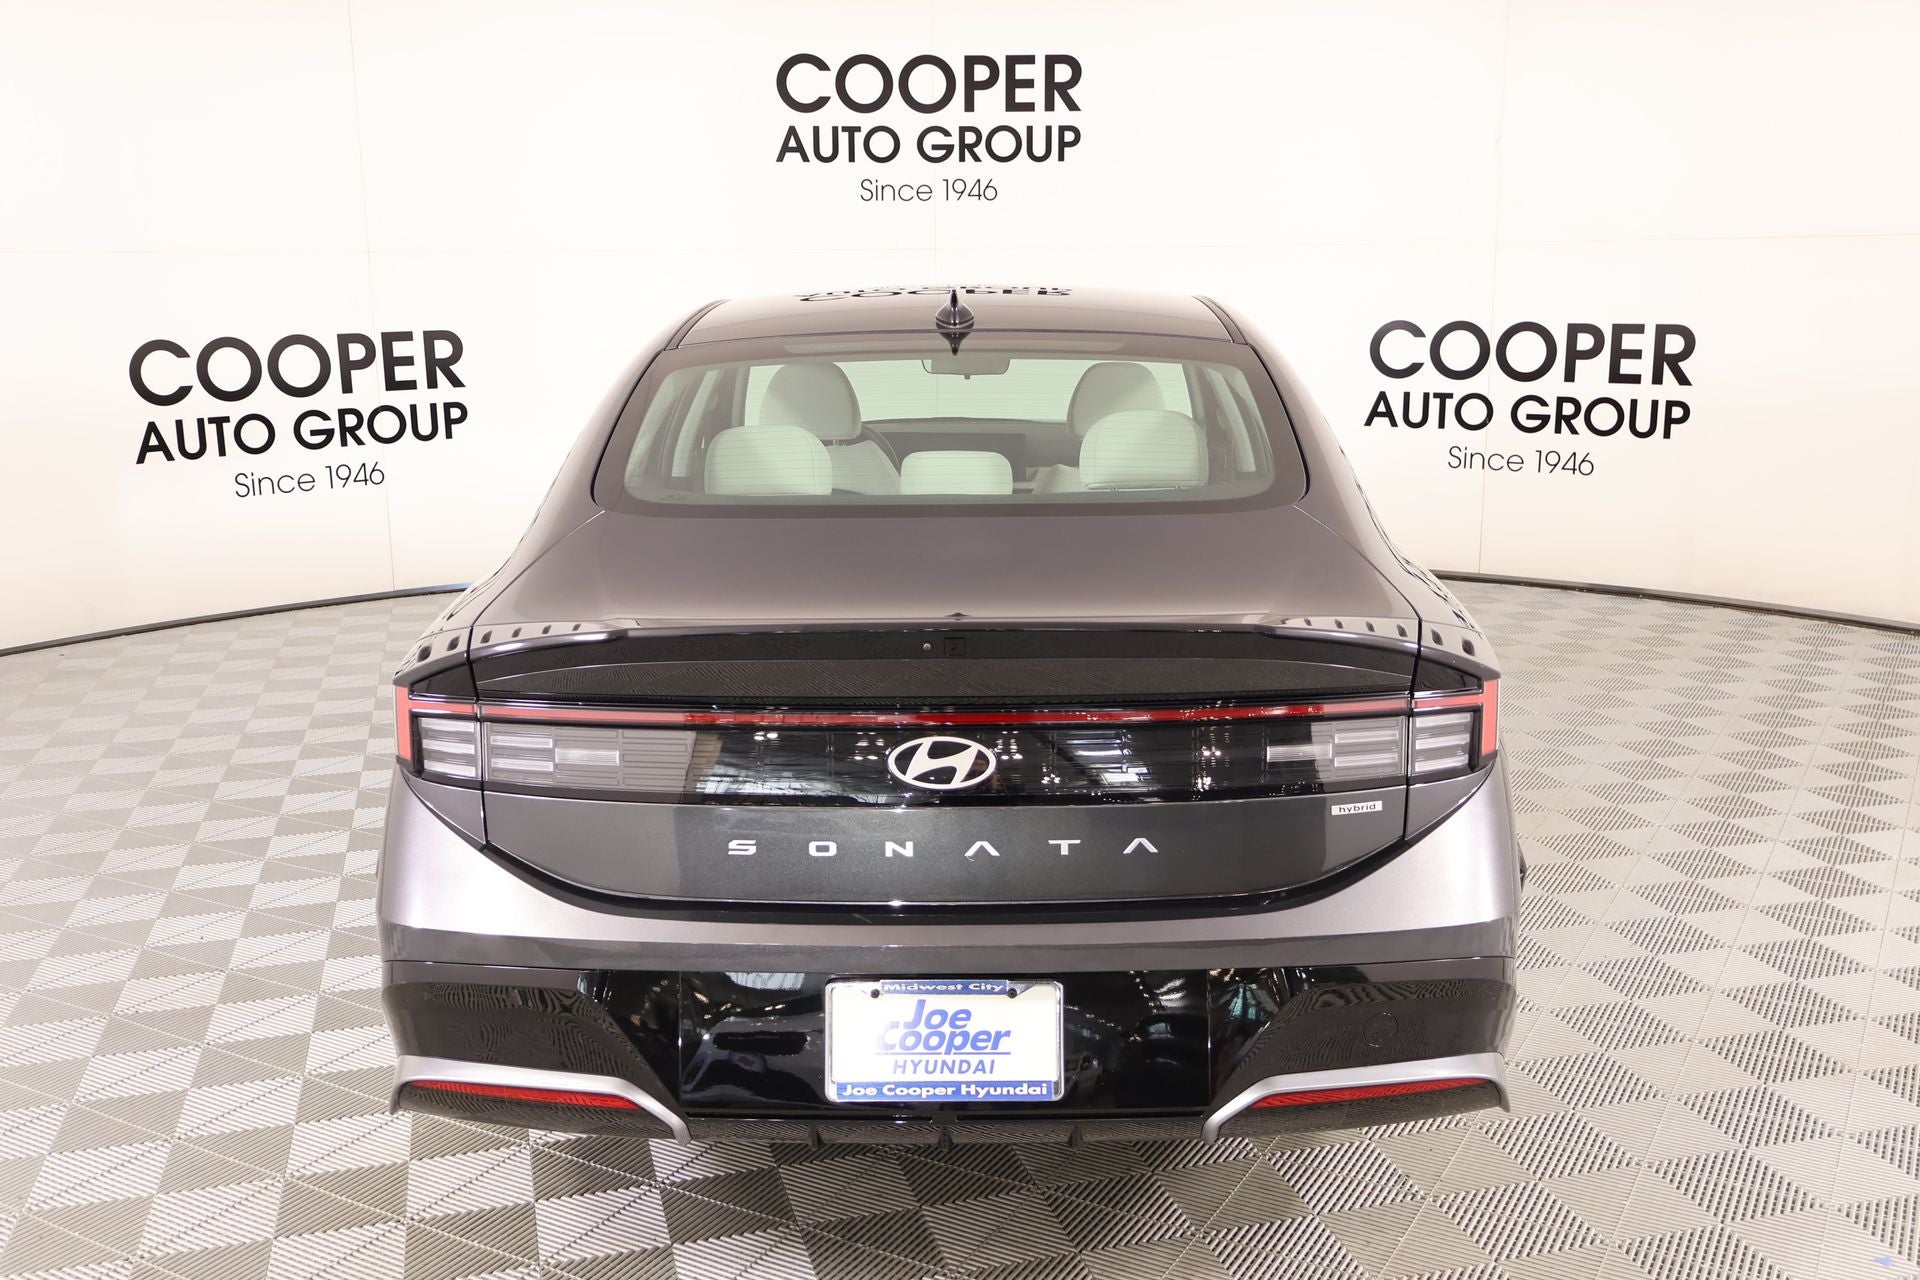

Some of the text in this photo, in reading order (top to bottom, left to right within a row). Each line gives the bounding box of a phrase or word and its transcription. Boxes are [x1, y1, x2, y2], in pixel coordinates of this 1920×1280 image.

[776, 53, 1083, 114] COOPER
[776, 125, 1082, 164] AUTO GROUP
[860, 178, 999, 202] Since 1946
[129, 329, 466, 407] COOPER
[1369, 319, 1697, 387] COOPER
[1363, 390, 1691, 440] AUTO GROUP
[135, 401, 468, 465] AUTO GROUP
[1447, 445, 1595, 477] Since 1946
[234, 461, 385, 498] Since 1946
[1339, 803, 1376, 813] hybrid
[727, 837, 1159, 857] SONATA
[884, 982, 1004, 993] Midwest City
[903, 999, 972, 1030] Joe
[877, 1020, 1011, 1055] Cooper
[892, 1059, 995, 1075] HYUNDAI
[842, 1083, 1047, 1098] Joe Cooper Hyundai
